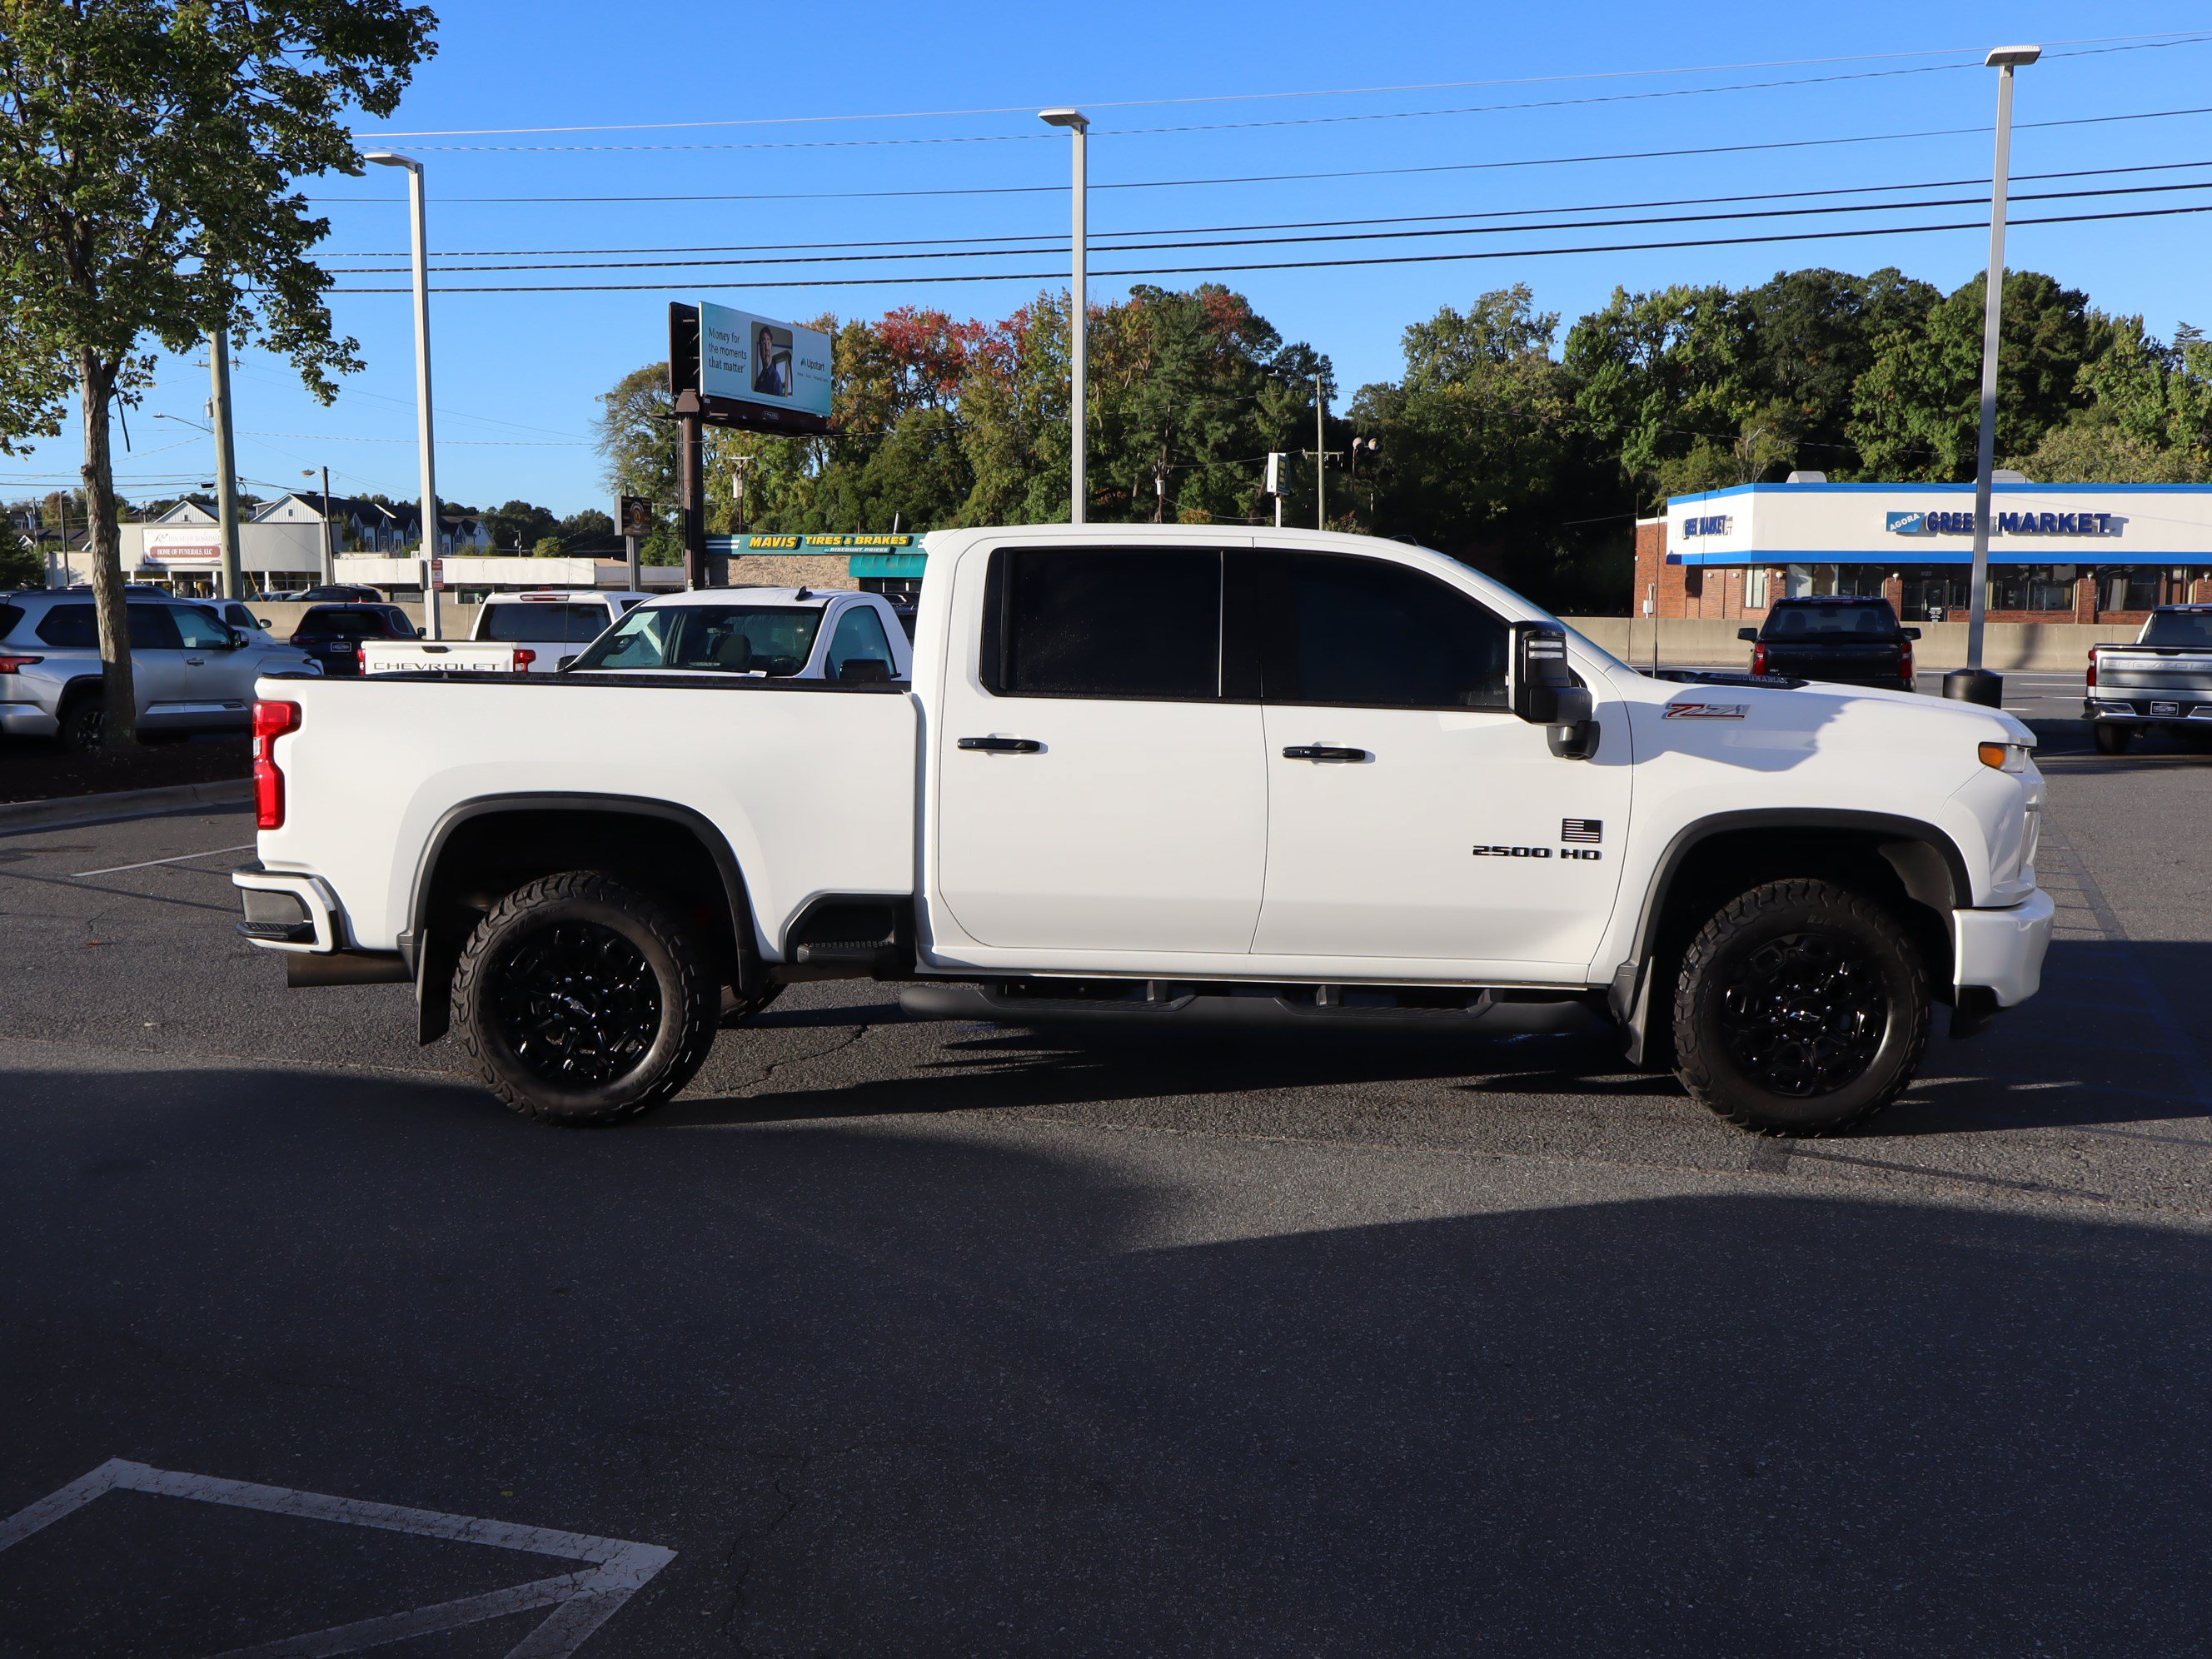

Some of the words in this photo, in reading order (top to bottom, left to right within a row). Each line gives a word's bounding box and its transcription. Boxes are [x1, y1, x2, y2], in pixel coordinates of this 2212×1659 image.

[708, 326, 730, 344] Money
[731, 332, 740, 343] for
[708, 342, 719, 354] the
[720, 346, 747, 360] moments
[708, 356, 722, 369] that
[806, 357, 825, 372] Upstart
[1890, 513, 1921, 531] AGORA
[1926, 511, 1975, 532] GREE
[1999, 512, 2111, 533] MARKET
[749, 536, 797, 548] MAVIS
[805, 536, 842, 545] TIRES
[844, 536, 853, 545] &
[854, 536, 908, 546] BRAKES
[374, 662, 501, 671] CHEVROLET
[1472, 845, 1552, 858] 2500
[1561, 849, 1602, 860] HD
